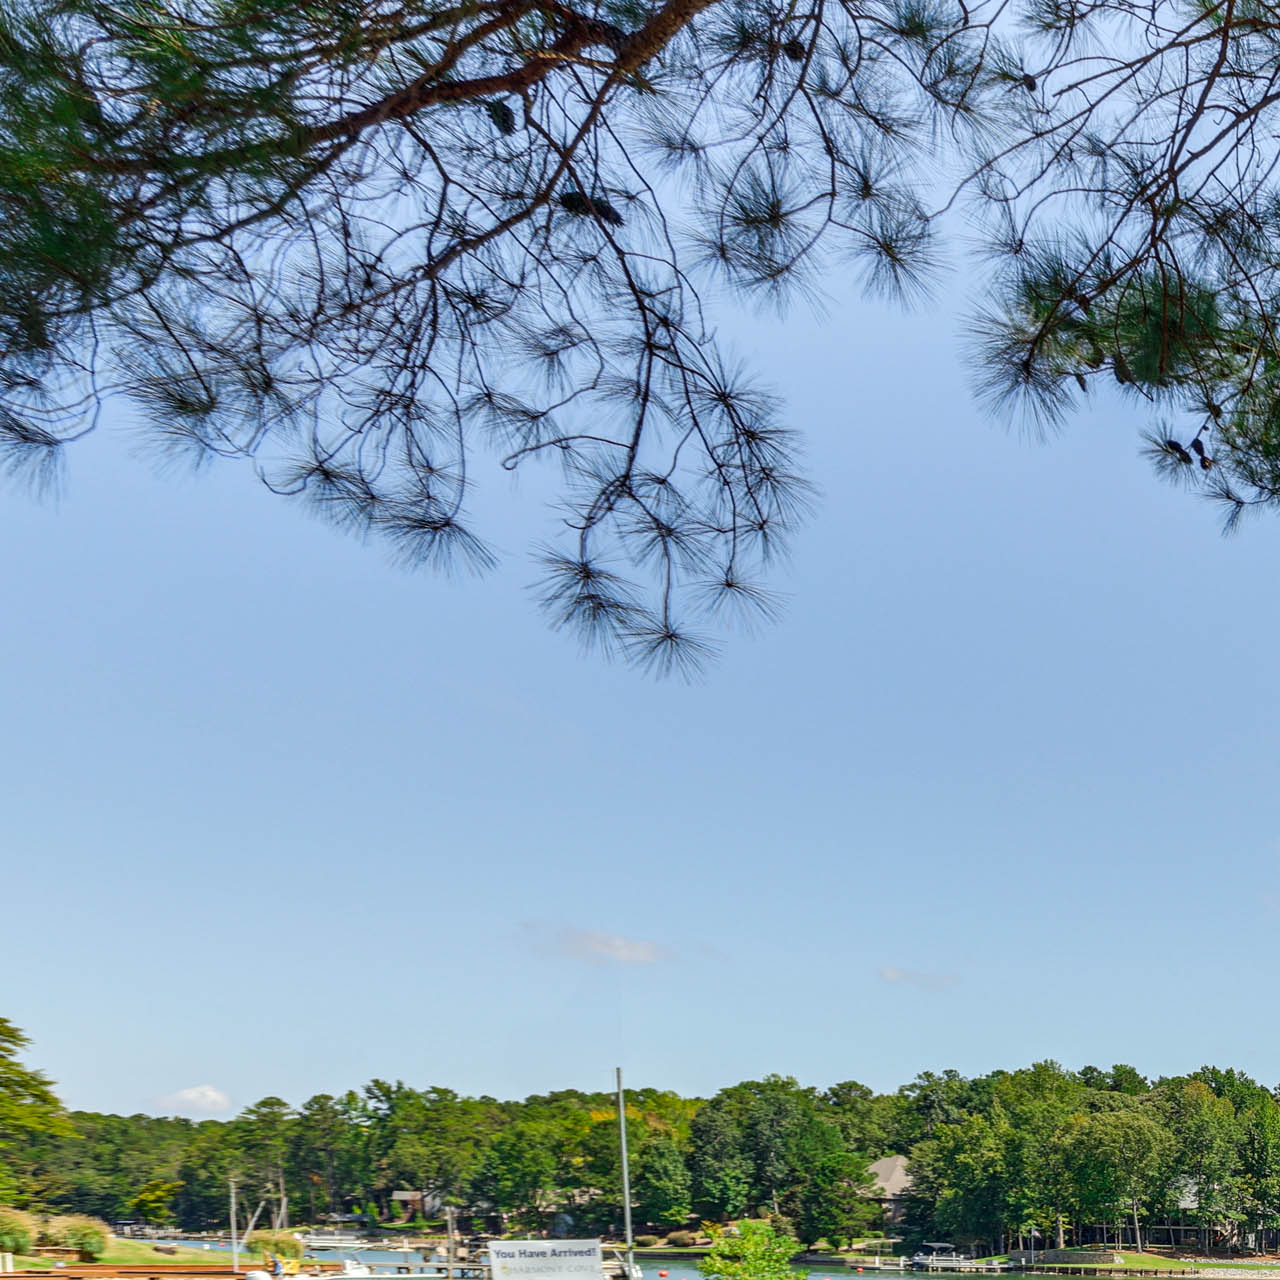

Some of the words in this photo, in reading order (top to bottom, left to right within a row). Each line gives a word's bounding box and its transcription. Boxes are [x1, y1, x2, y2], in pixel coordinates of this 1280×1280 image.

[494, 1249, 516, 1259] You
[518, 1248, 547, 1258] Have
[550, 1247, 597, 1257] Arrived!
